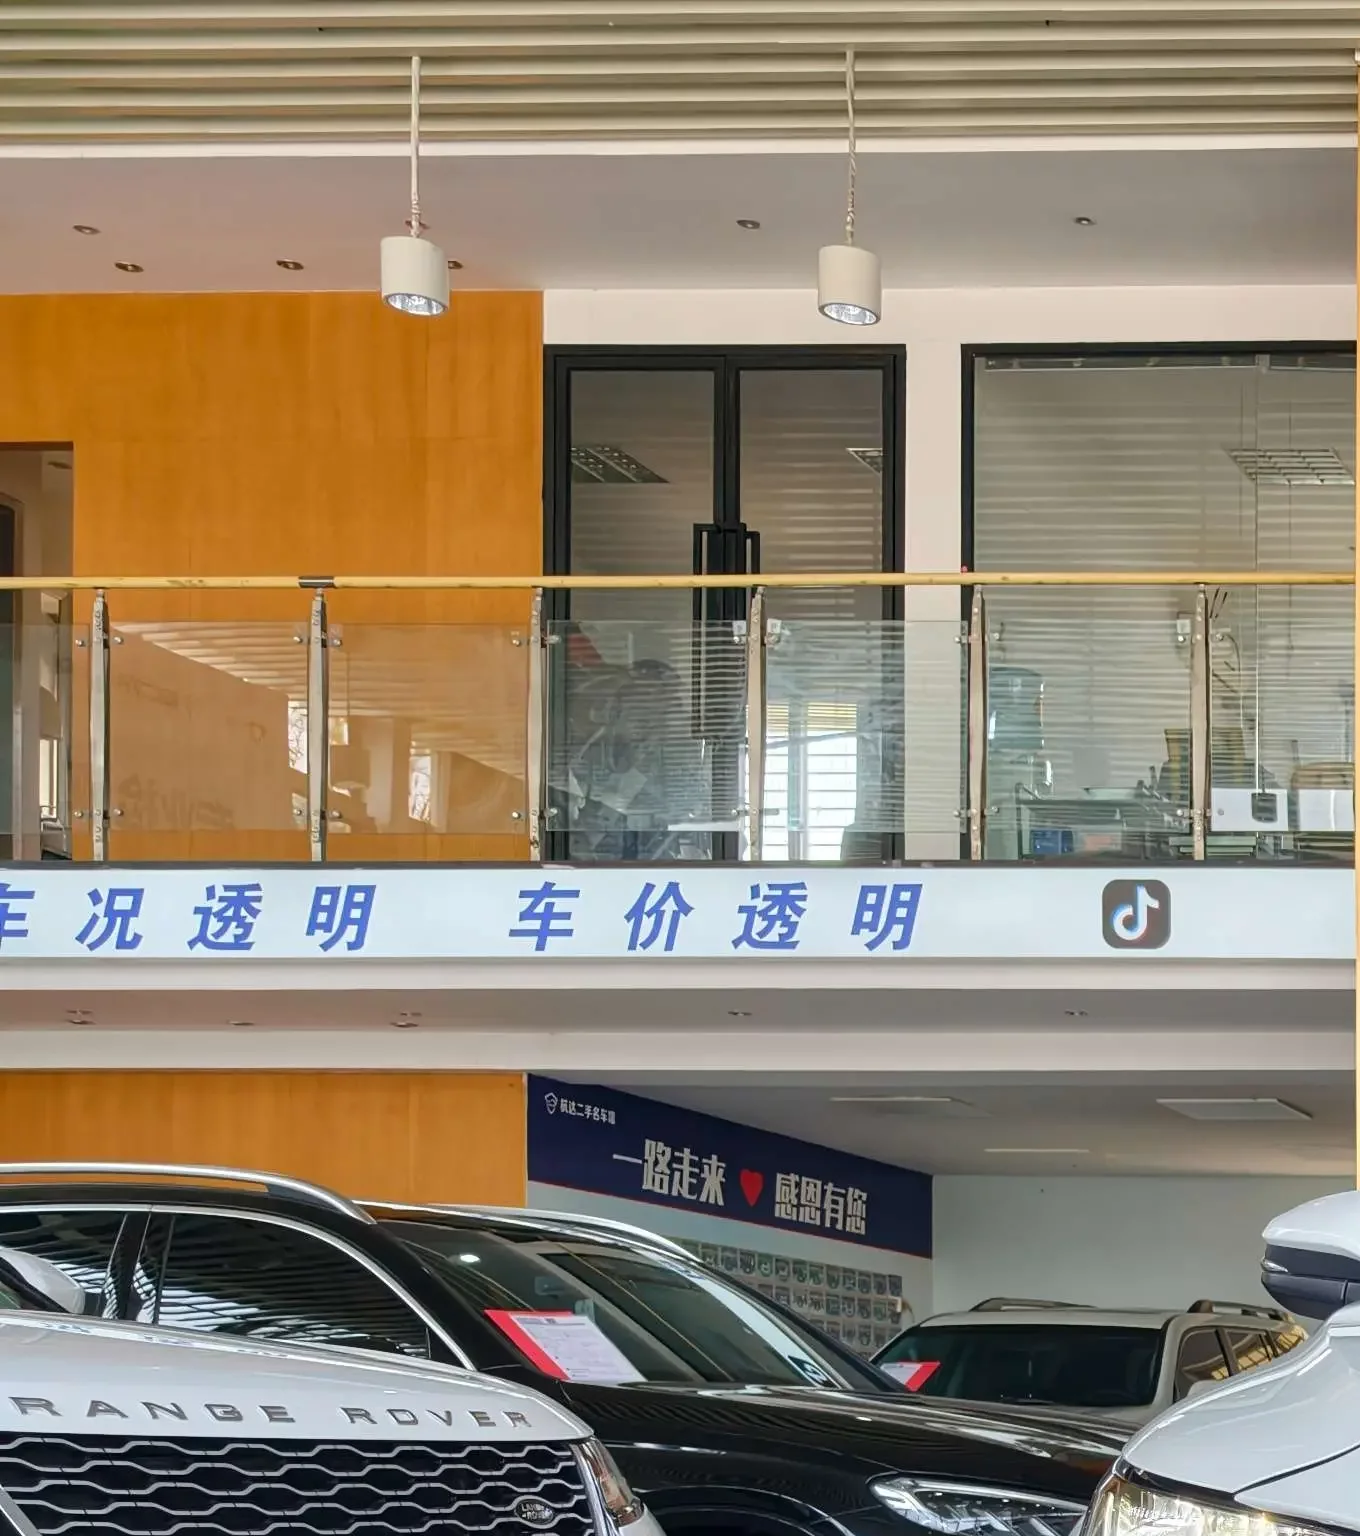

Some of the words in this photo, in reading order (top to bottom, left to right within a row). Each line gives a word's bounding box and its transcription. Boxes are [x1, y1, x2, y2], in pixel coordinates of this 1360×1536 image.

[510, 881, 922, 952] 车价透明
[612, 1138, 727, 1207] 一路走来
[774, 1172, 868, 1236] 感恩有您
[8, 1396, 296, 1423] RANGE
[339, 1407, 533, 1428] ROVER
